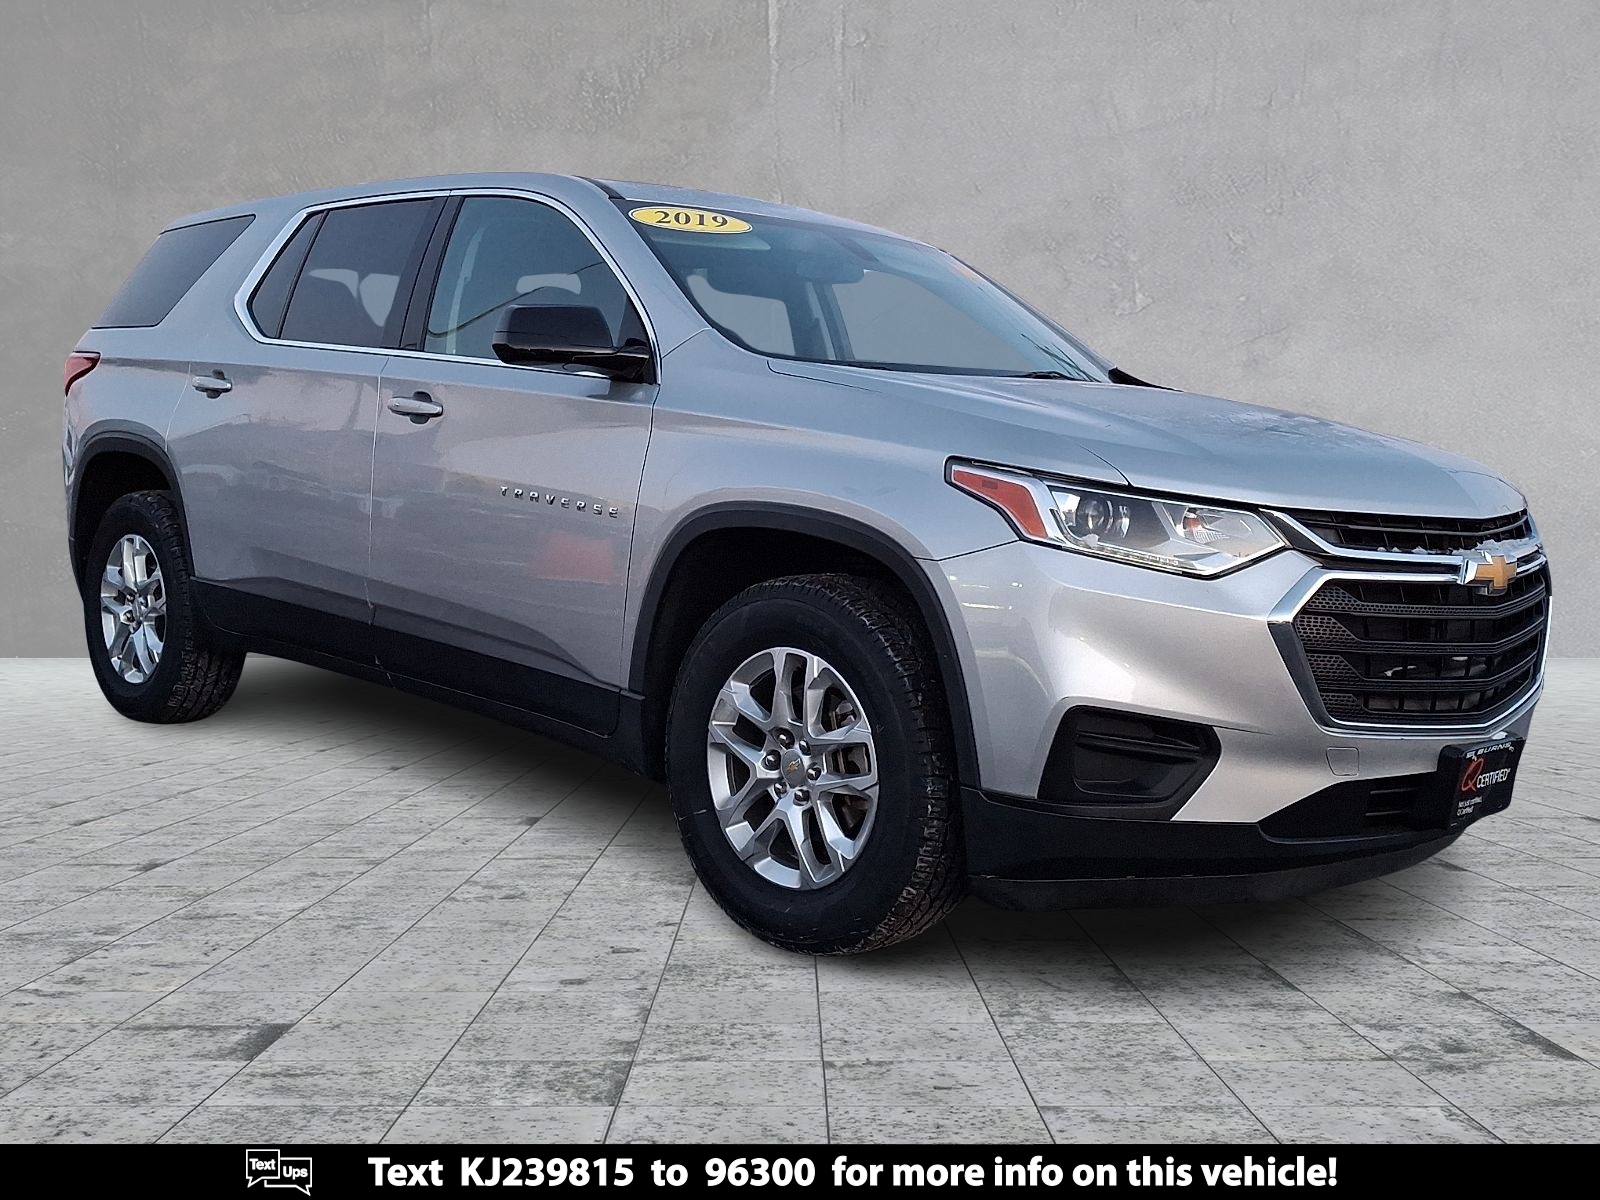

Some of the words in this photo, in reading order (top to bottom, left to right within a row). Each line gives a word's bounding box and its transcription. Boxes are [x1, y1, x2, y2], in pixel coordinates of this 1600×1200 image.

[654, 210, 729, 228] 2019
[500, 485, 619, 519] TRAVERSE
[1476, 768, 1511, 789] CERTIFIED
